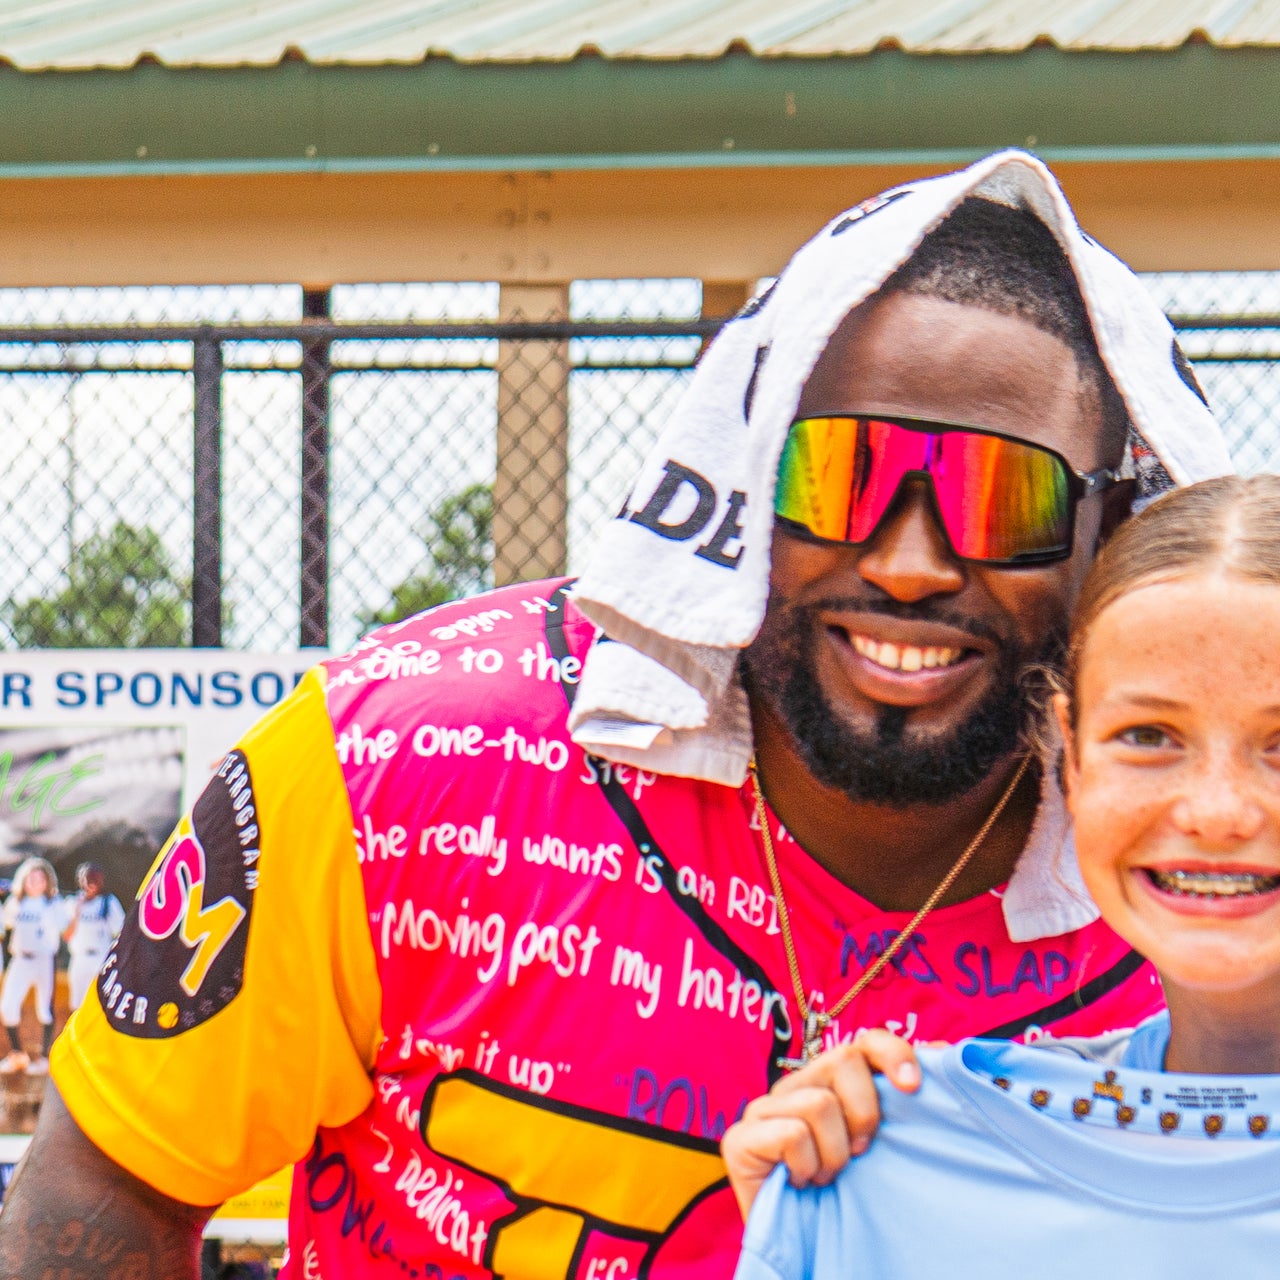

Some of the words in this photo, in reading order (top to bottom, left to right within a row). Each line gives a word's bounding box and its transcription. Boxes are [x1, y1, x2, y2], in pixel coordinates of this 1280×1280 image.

[617, 459, 748, 570] DE
[457, 646, 504, 673] to
[517, 641, 582, 684] the
[336, 724, 398, 764] the
[412, 724, 569, 772] one-two
[135, 808, 247, 998] SM
[419, 814, 508, 877] really
[523, 834, 623, 883] wants
[634, 842, 665, 894] is
[676, 868, 716, 907] an
[507, 921, 602, 988] past
[610, 943, 663, 1019] my
[677, 937, 794, 1042] haters
[475, 1030, 501, 1075] it
[395, 1149, 488, 1266] dedicat
